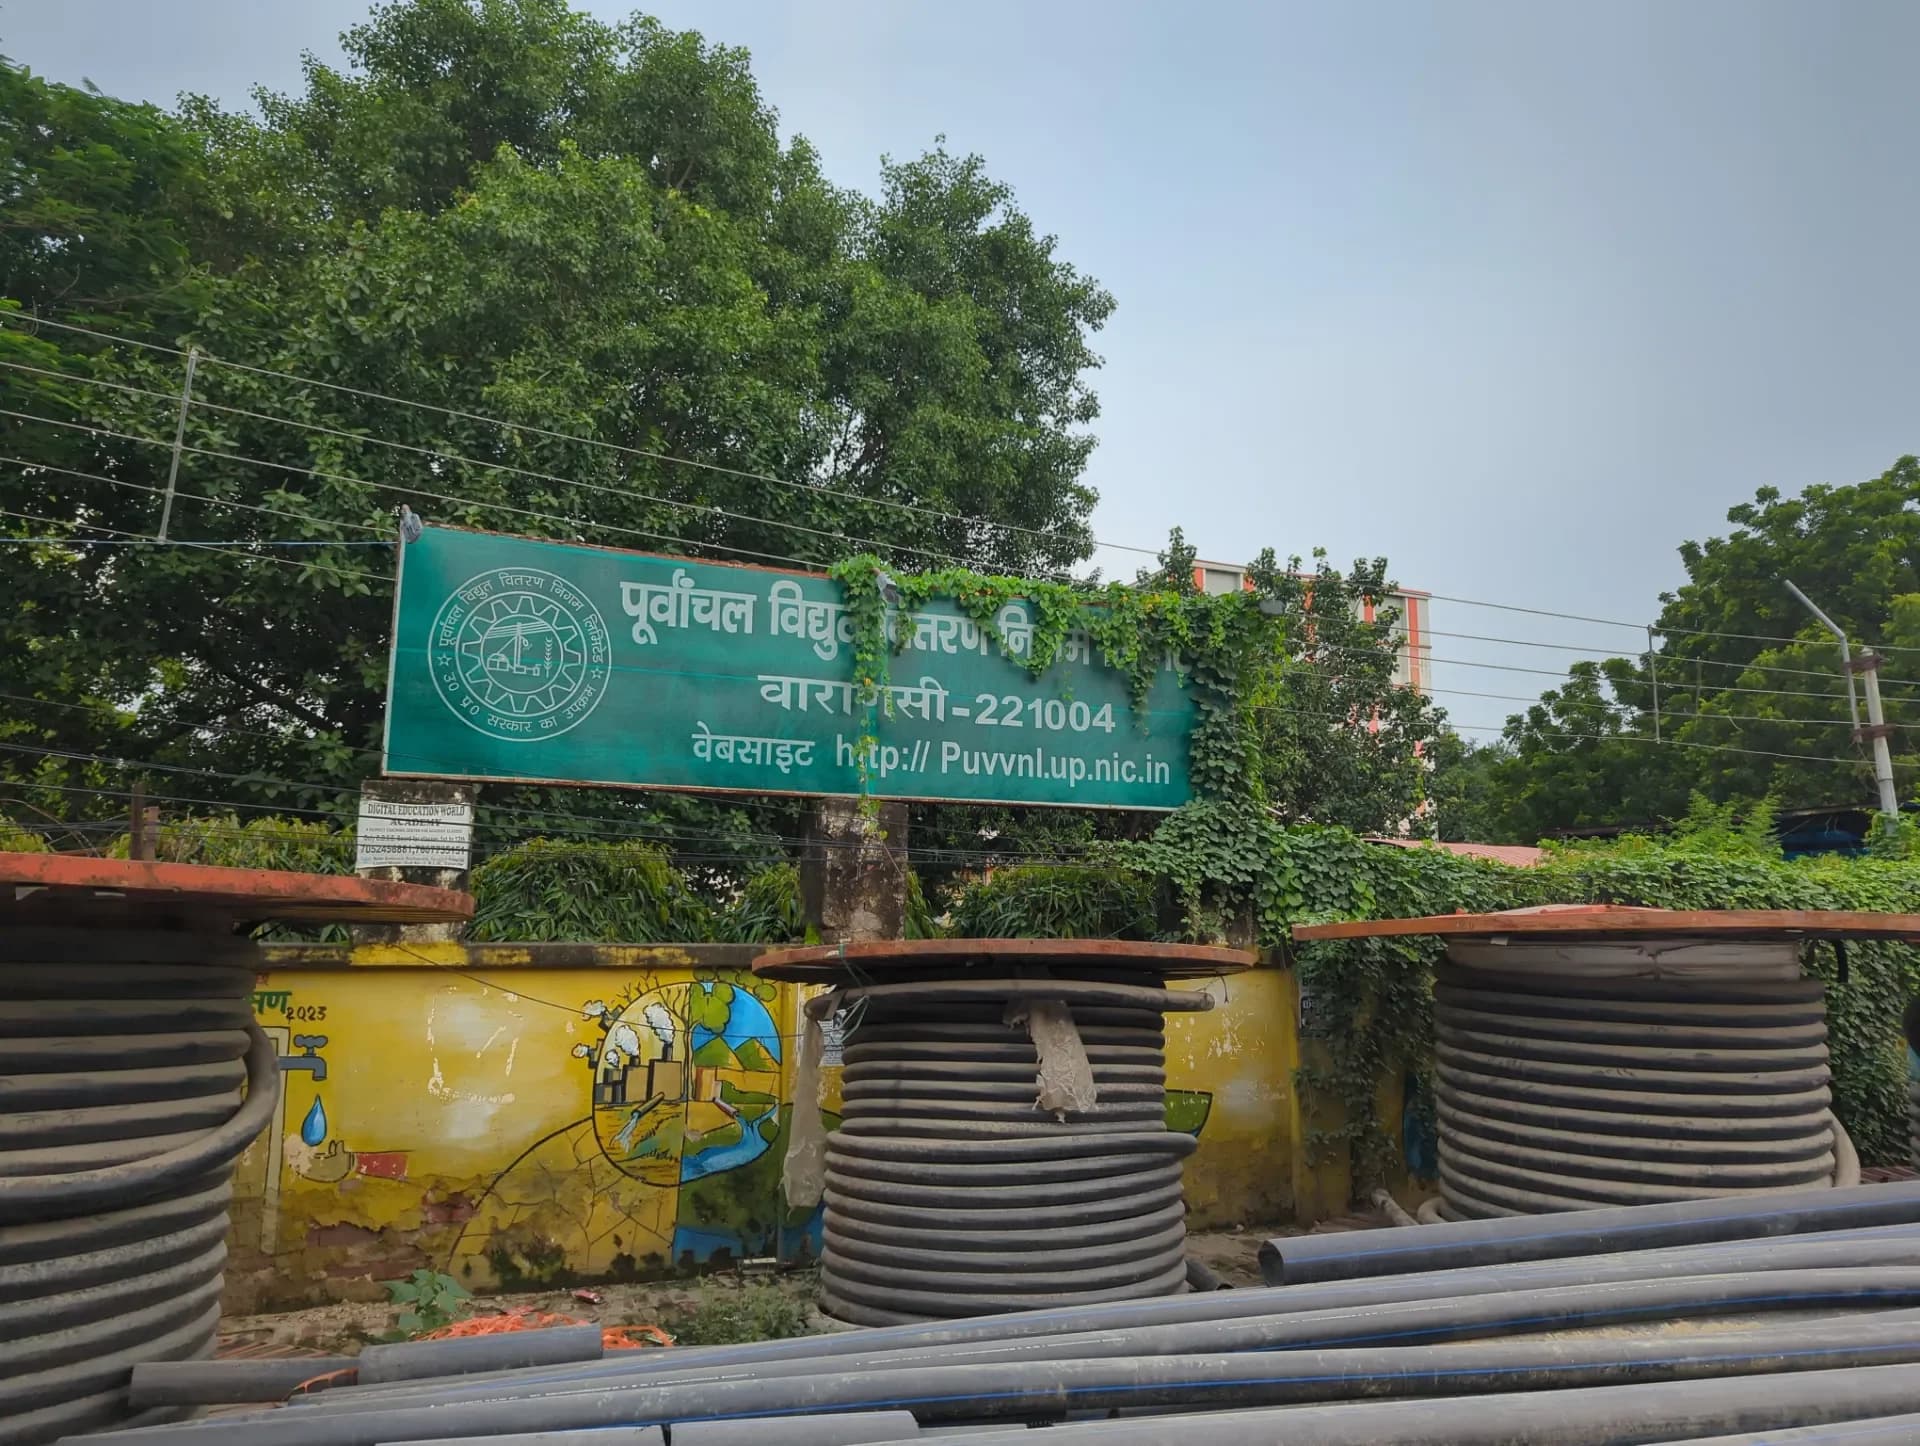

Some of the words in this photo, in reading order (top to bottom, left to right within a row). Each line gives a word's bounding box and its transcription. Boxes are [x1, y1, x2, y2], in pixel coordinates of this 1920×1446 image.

[498, 572, 545, 589] वितरण
[550, 580, 585, 611] निगम
[620, 568, 757, 645] पूर्वांचल
[487, 713, 533, 733] सरकार
[538, 716, 558, 730] का
[691, 721, 816, 774] वेबसाइट
[941, 741, 1170, 787] Puvvnl.up.nic.in
[367, 803, 396, 815] DIGITAL
[399, 804, 440, 816] EDUCATION
[440, 806, 465, 817] WORLD
[286, 1005, 327, 1023] 2023
